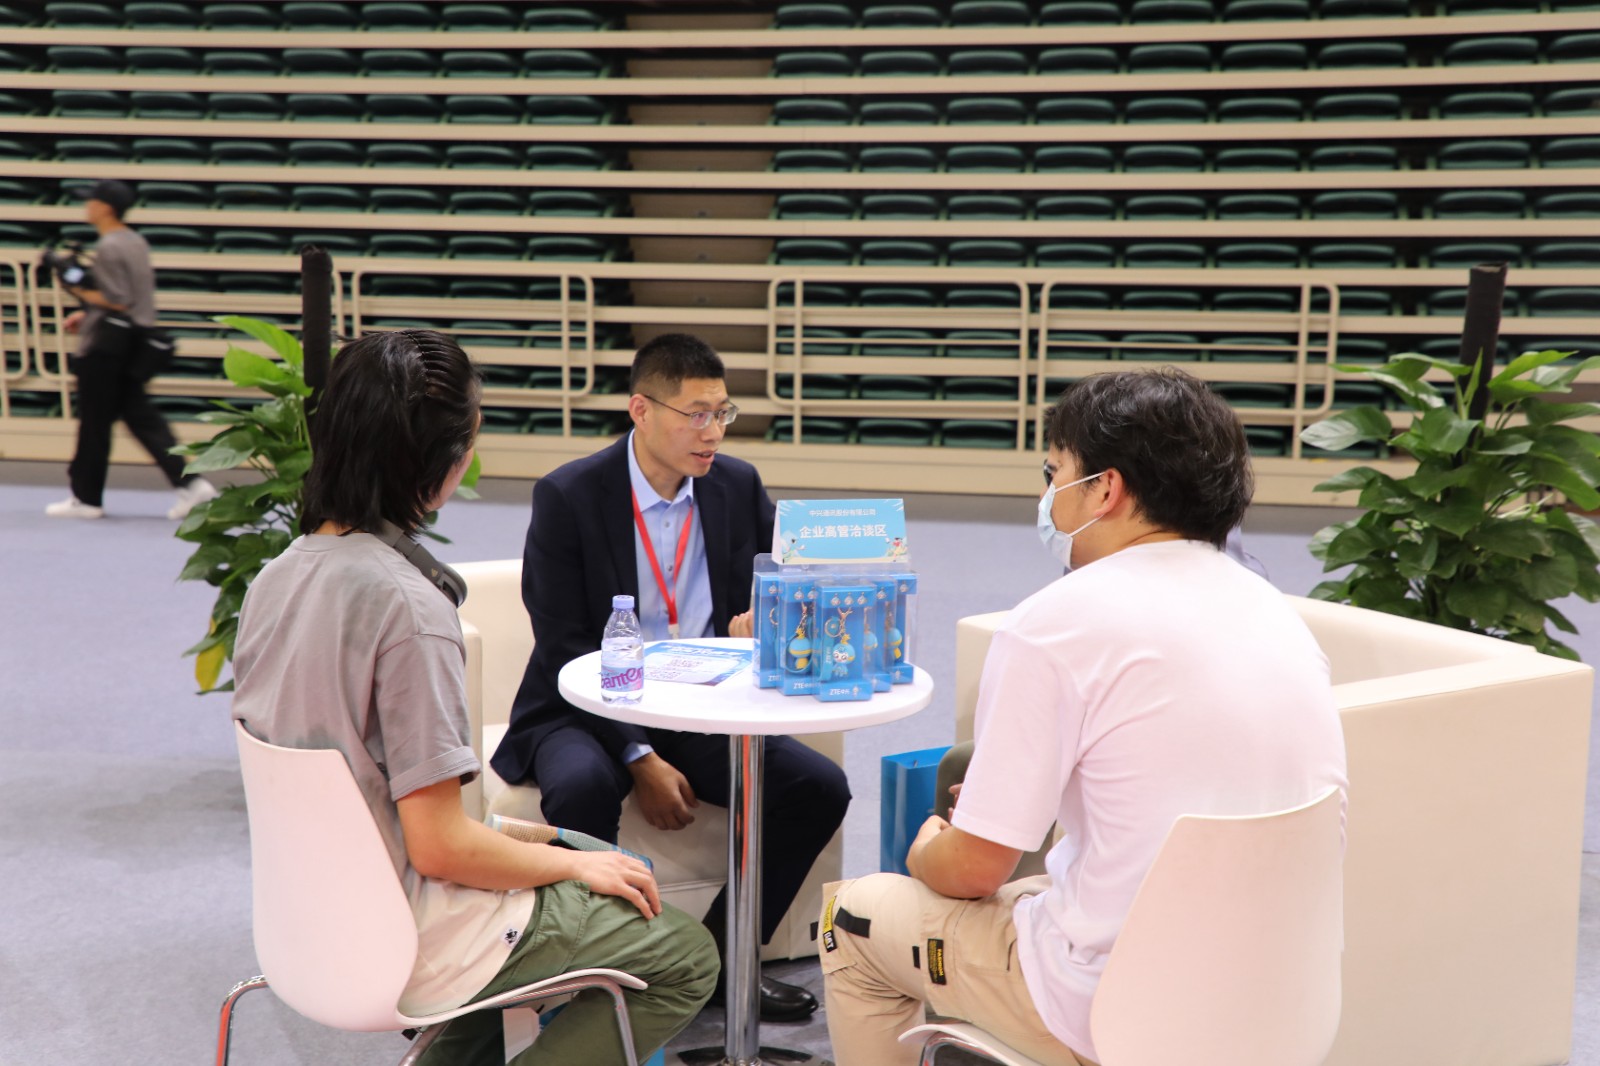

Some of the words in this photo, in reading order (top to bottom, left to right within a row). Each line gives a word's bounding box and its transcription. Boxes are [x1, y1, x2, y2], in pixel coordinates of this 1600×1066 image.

[799, 524, 887, 538] 企业高管洽谈区
